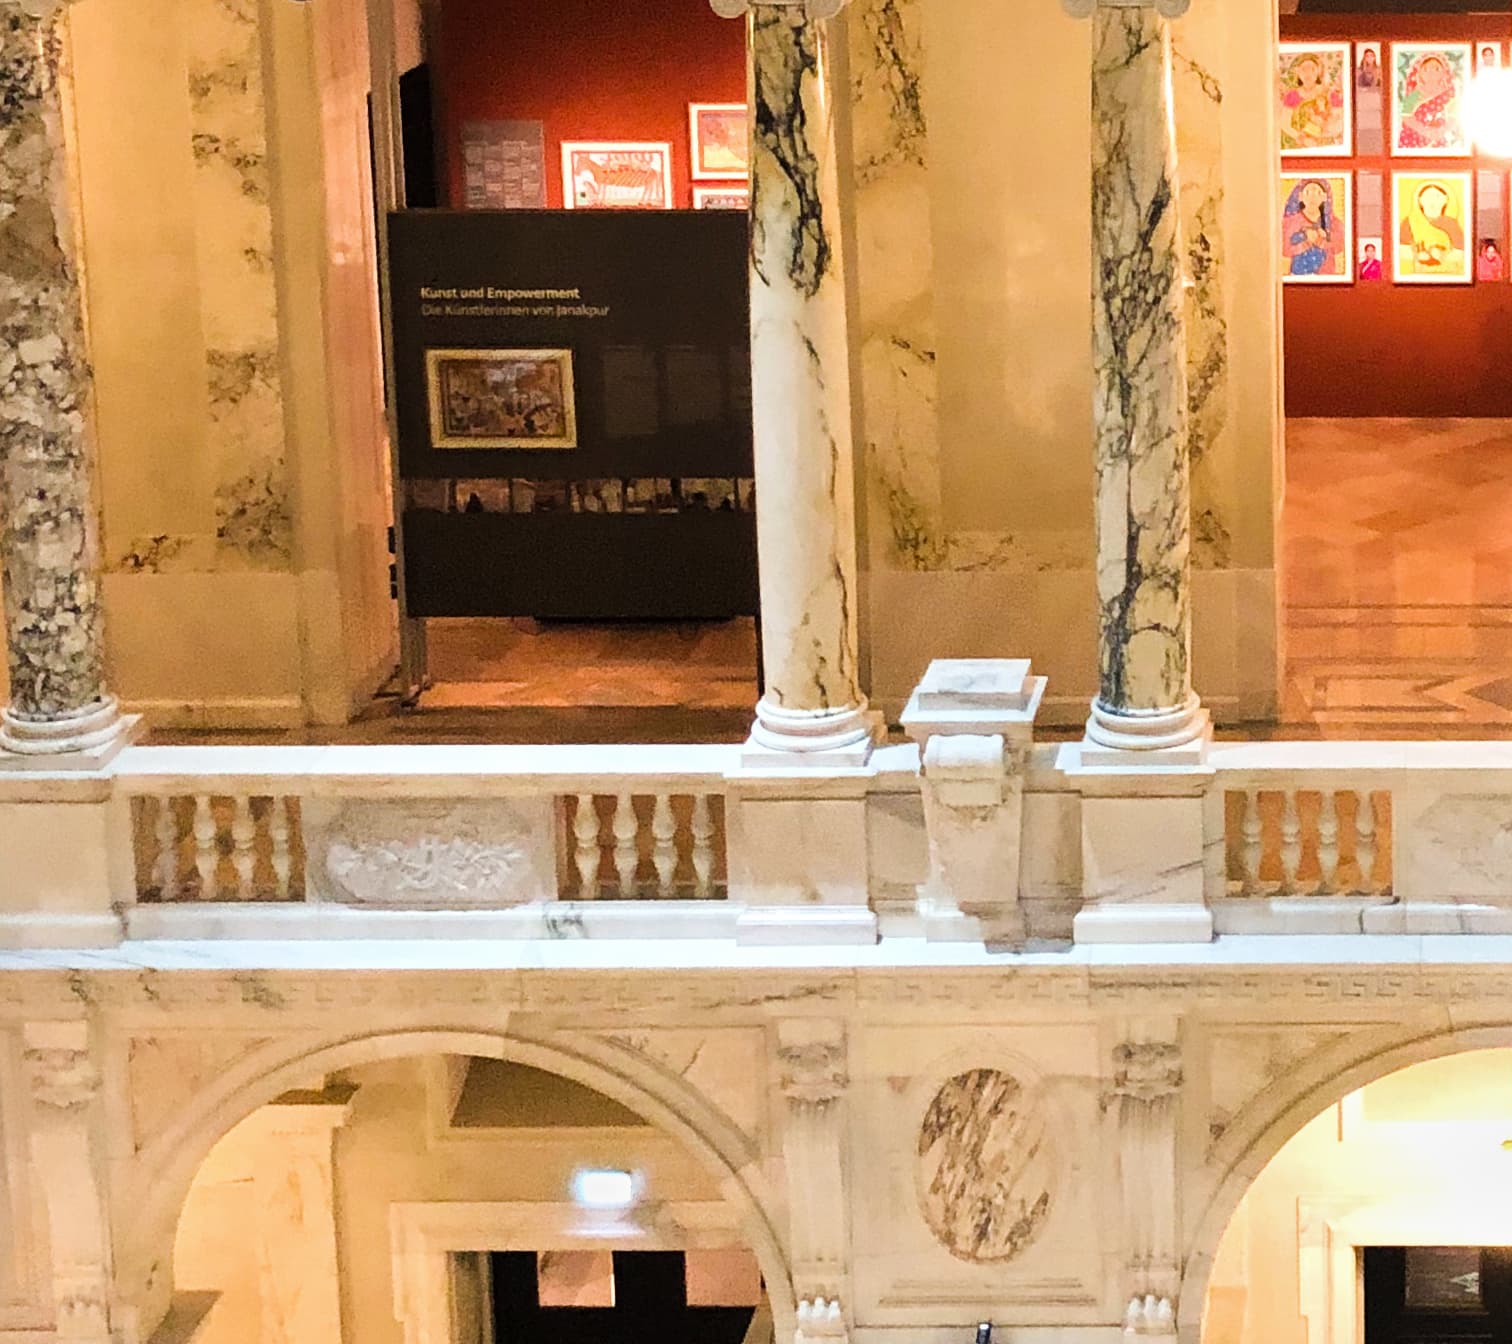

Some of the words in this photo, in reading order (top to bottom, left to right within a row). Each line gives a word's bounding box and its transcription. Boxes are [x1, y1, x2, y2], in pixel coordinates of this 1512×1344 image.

[421, 287, 458, 299] Kunst
[460, 287, 484, 299] und
[487, 287, 581, 301] Empowerment
[422, 303, 443, 316] Die
[533, 305, 553, 316] von
[556, 303, 610, 319] Janakpur
